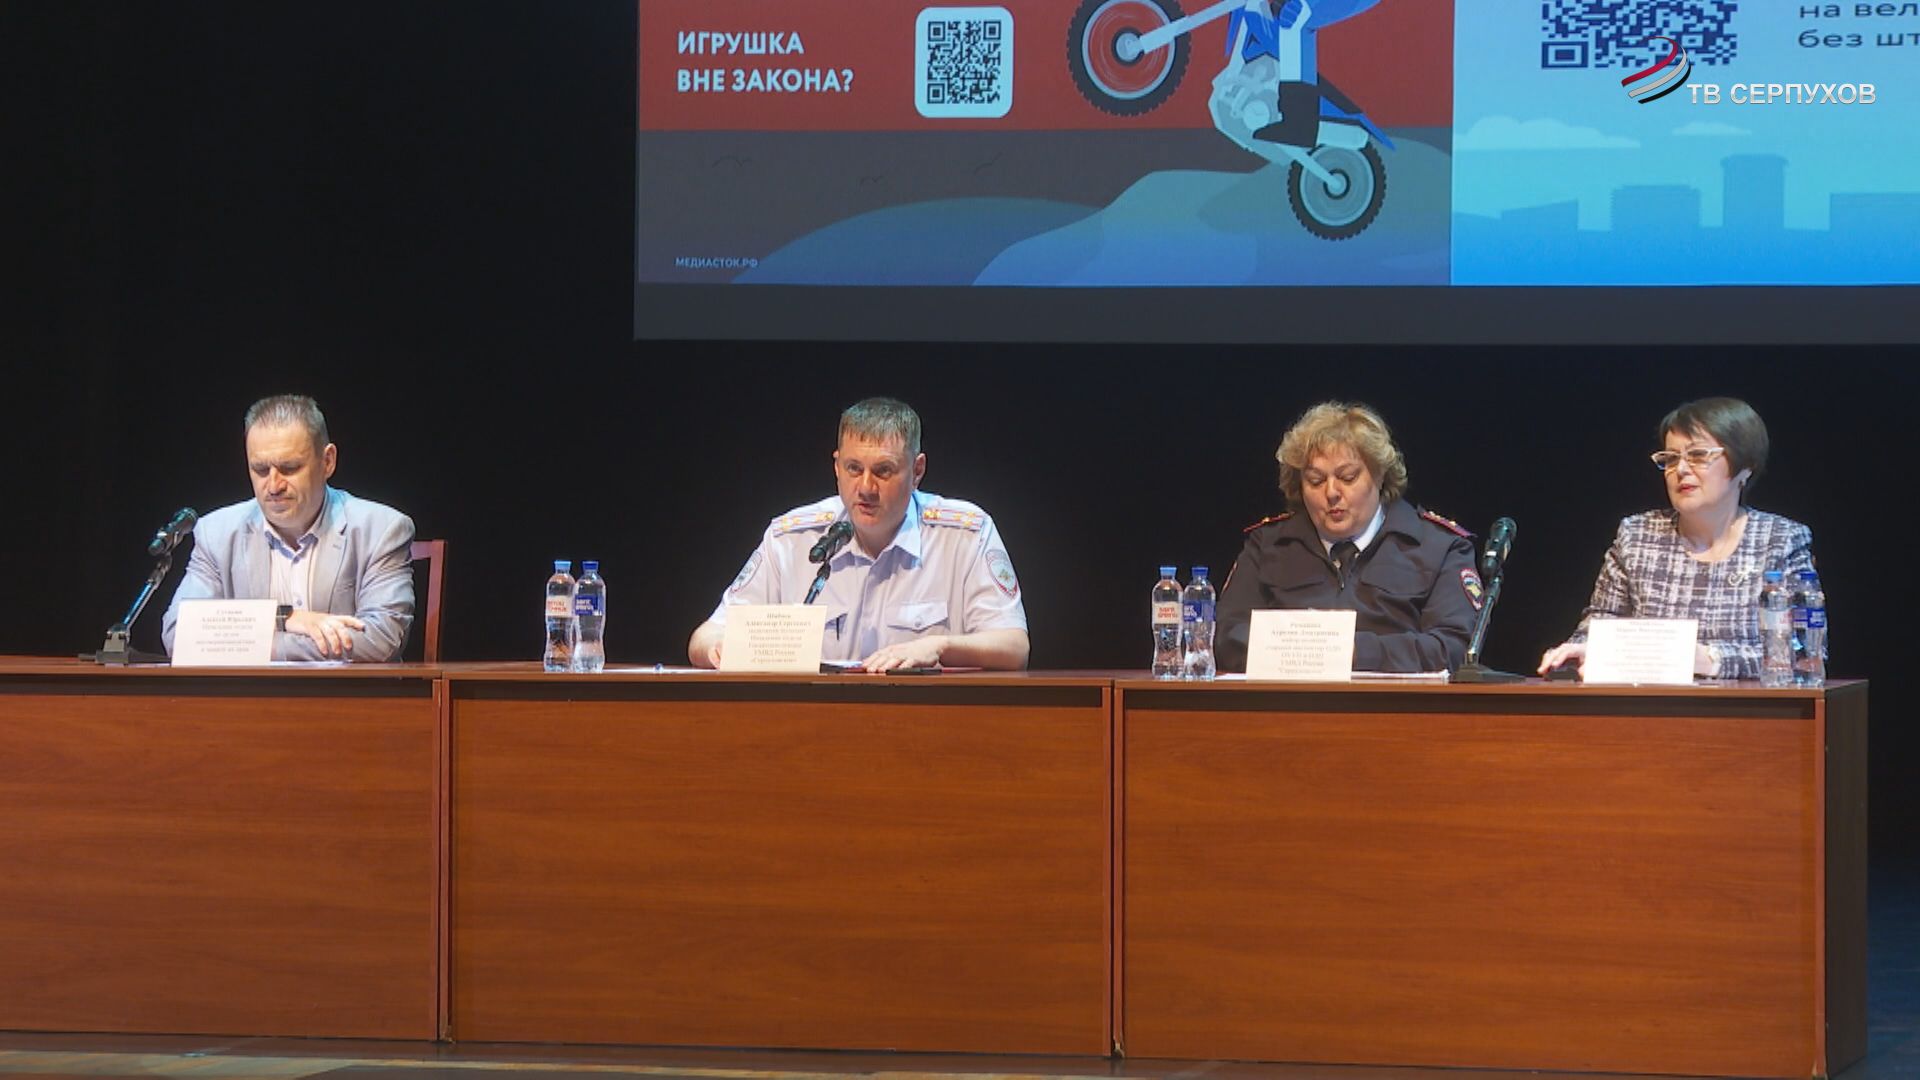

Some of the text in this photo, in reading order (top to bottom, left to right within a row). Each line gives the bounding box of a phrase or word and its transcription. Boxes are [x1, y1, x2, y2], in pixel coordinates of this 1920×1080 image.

[1799, 2, 1918, 18] на вел
[677, 31, 804, 55] ИГРУШКА
[1798, 28, 1863, 48] без
[677, 68, 854, 92] ВНЕ ЗАКОНА?
[675, 257, 759, 269] МЕДИАСТОК.РФ
